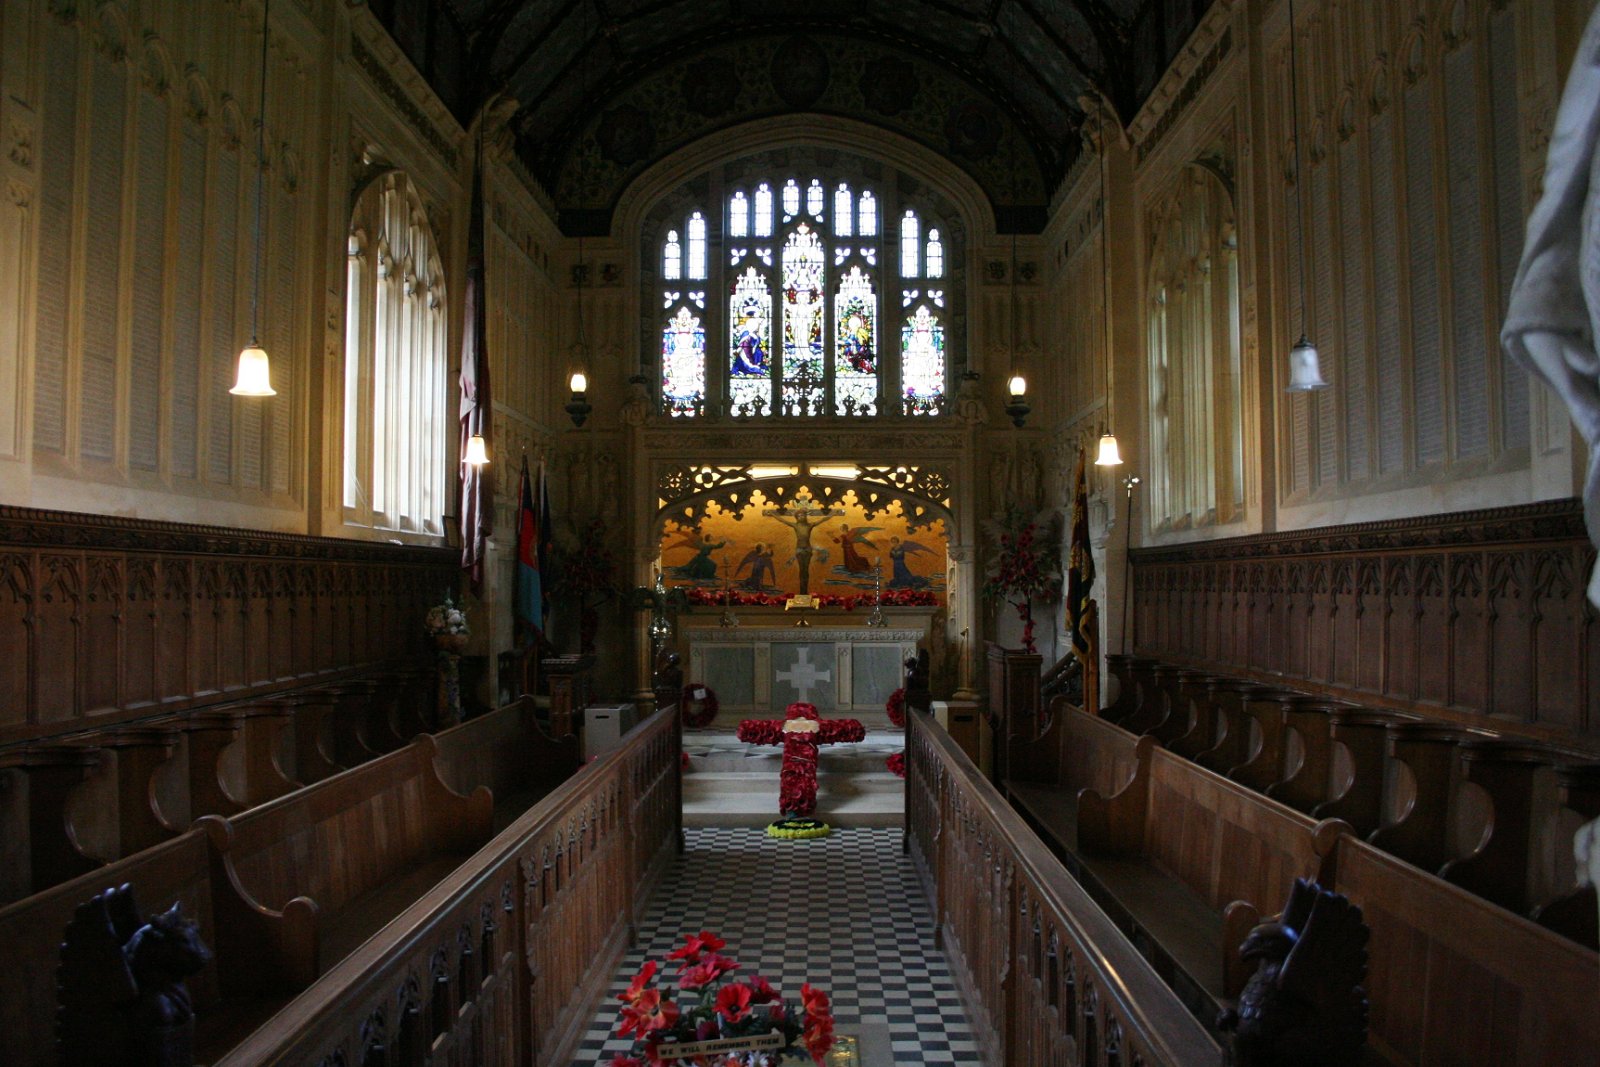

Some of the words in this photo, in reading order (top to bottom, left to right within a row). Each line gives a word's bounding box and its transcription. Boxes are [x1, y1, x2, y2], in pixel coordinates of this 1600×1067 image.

[680, 1046, 700, 1054] WILL
[705, 1041, 751, 1051] REMEMBER
[756, 1038, 780, 1046] THEM
